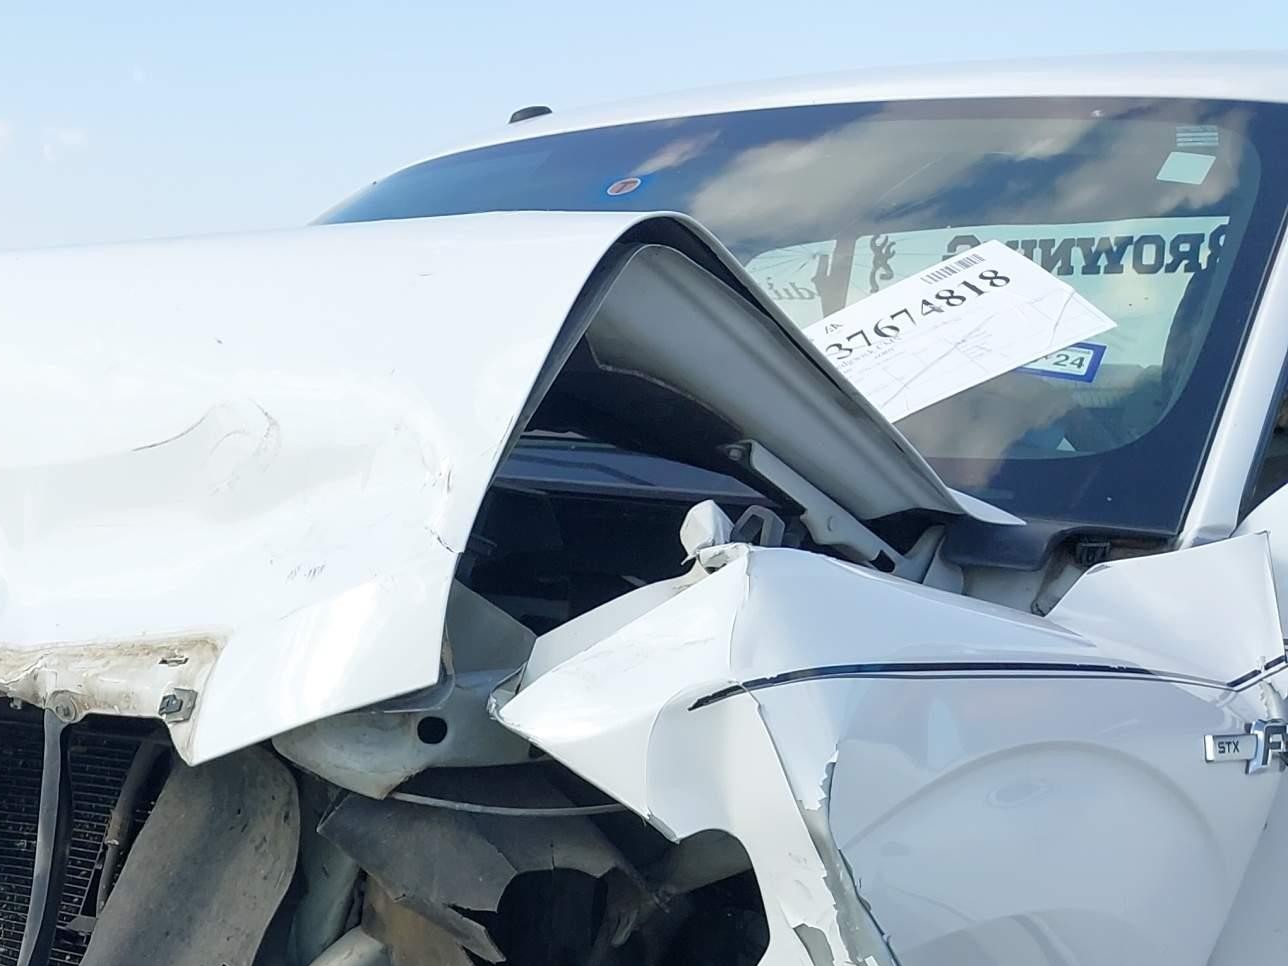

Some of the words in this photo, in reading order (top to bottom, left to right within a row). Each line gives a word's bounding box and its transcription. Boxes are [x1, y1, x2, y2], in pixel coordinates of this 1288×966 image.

[825, 269, 1011, 360] 37674818
[1053, 353, 1086, 369] 24
[1218, 741, 1240, 754] STX
